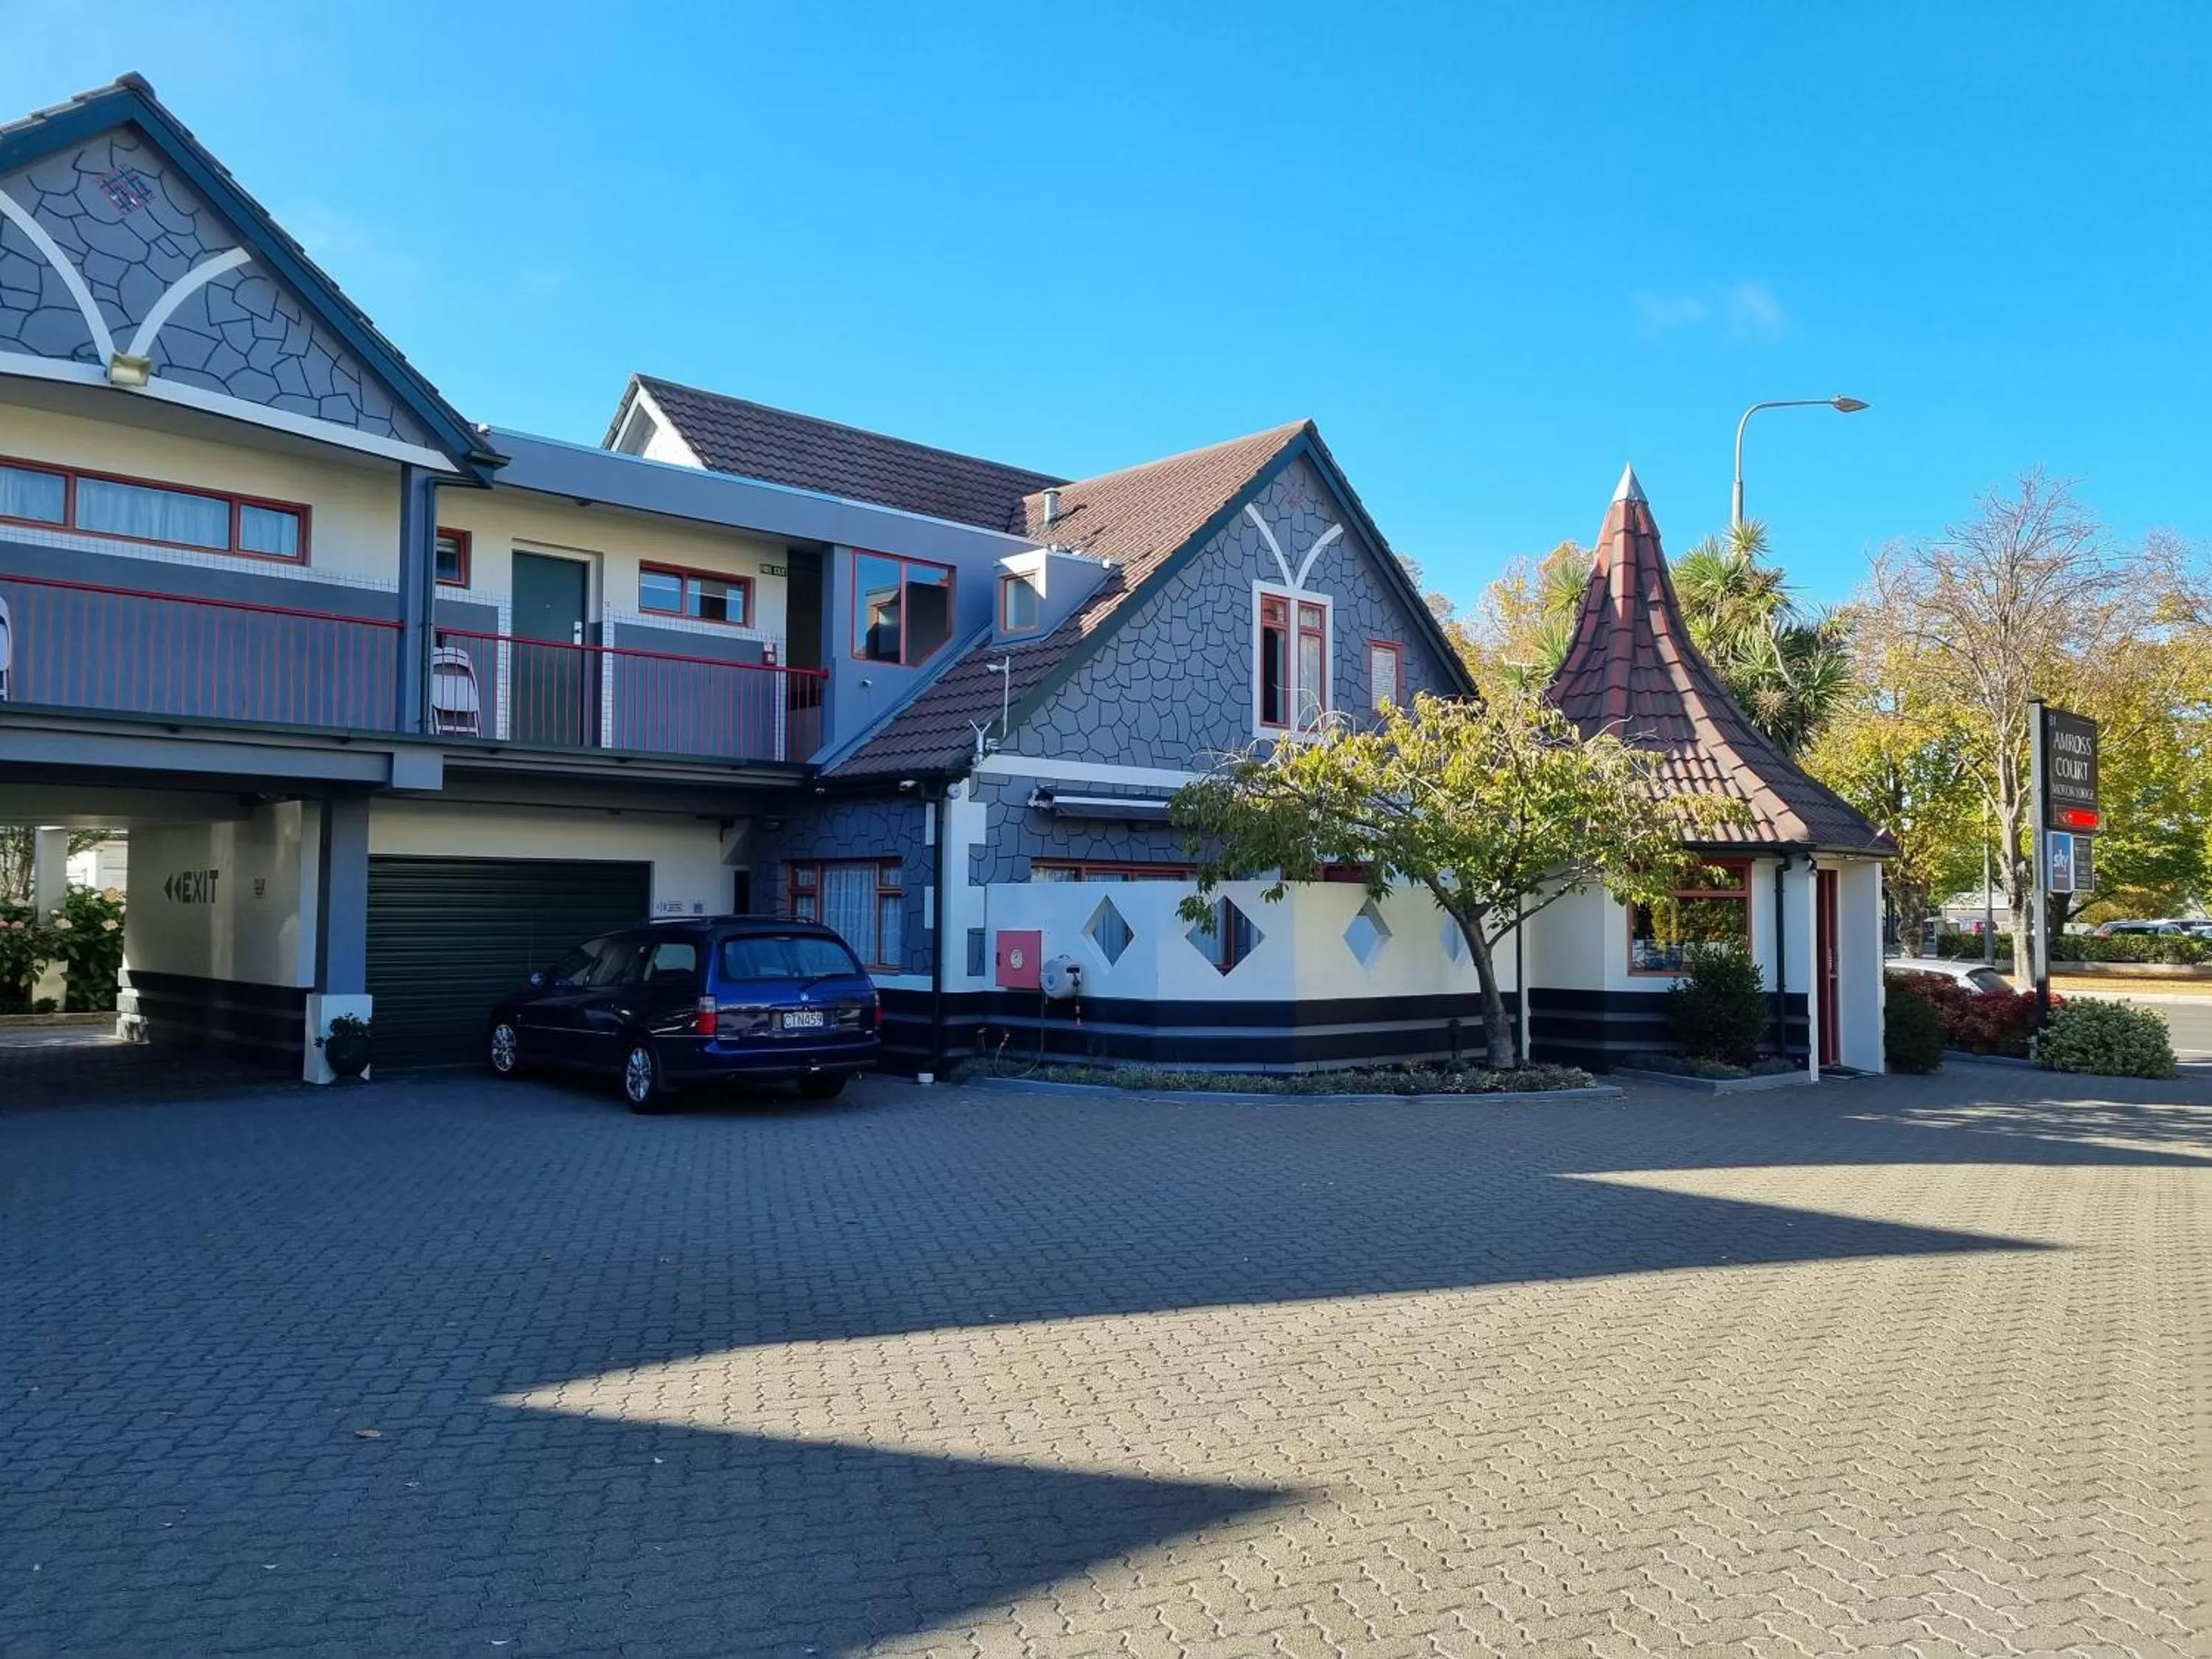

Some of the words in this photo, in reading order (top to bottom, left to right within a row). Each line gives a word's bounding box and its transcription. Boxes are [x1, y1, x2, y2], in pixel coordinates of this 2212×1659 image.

[2053, 731, 2092, 756] AMROSS
[2055, 758, 2088, 781] COURT
[2053, 849, 2069, 872] sky
[182, 869, 219, 903] EXIT
